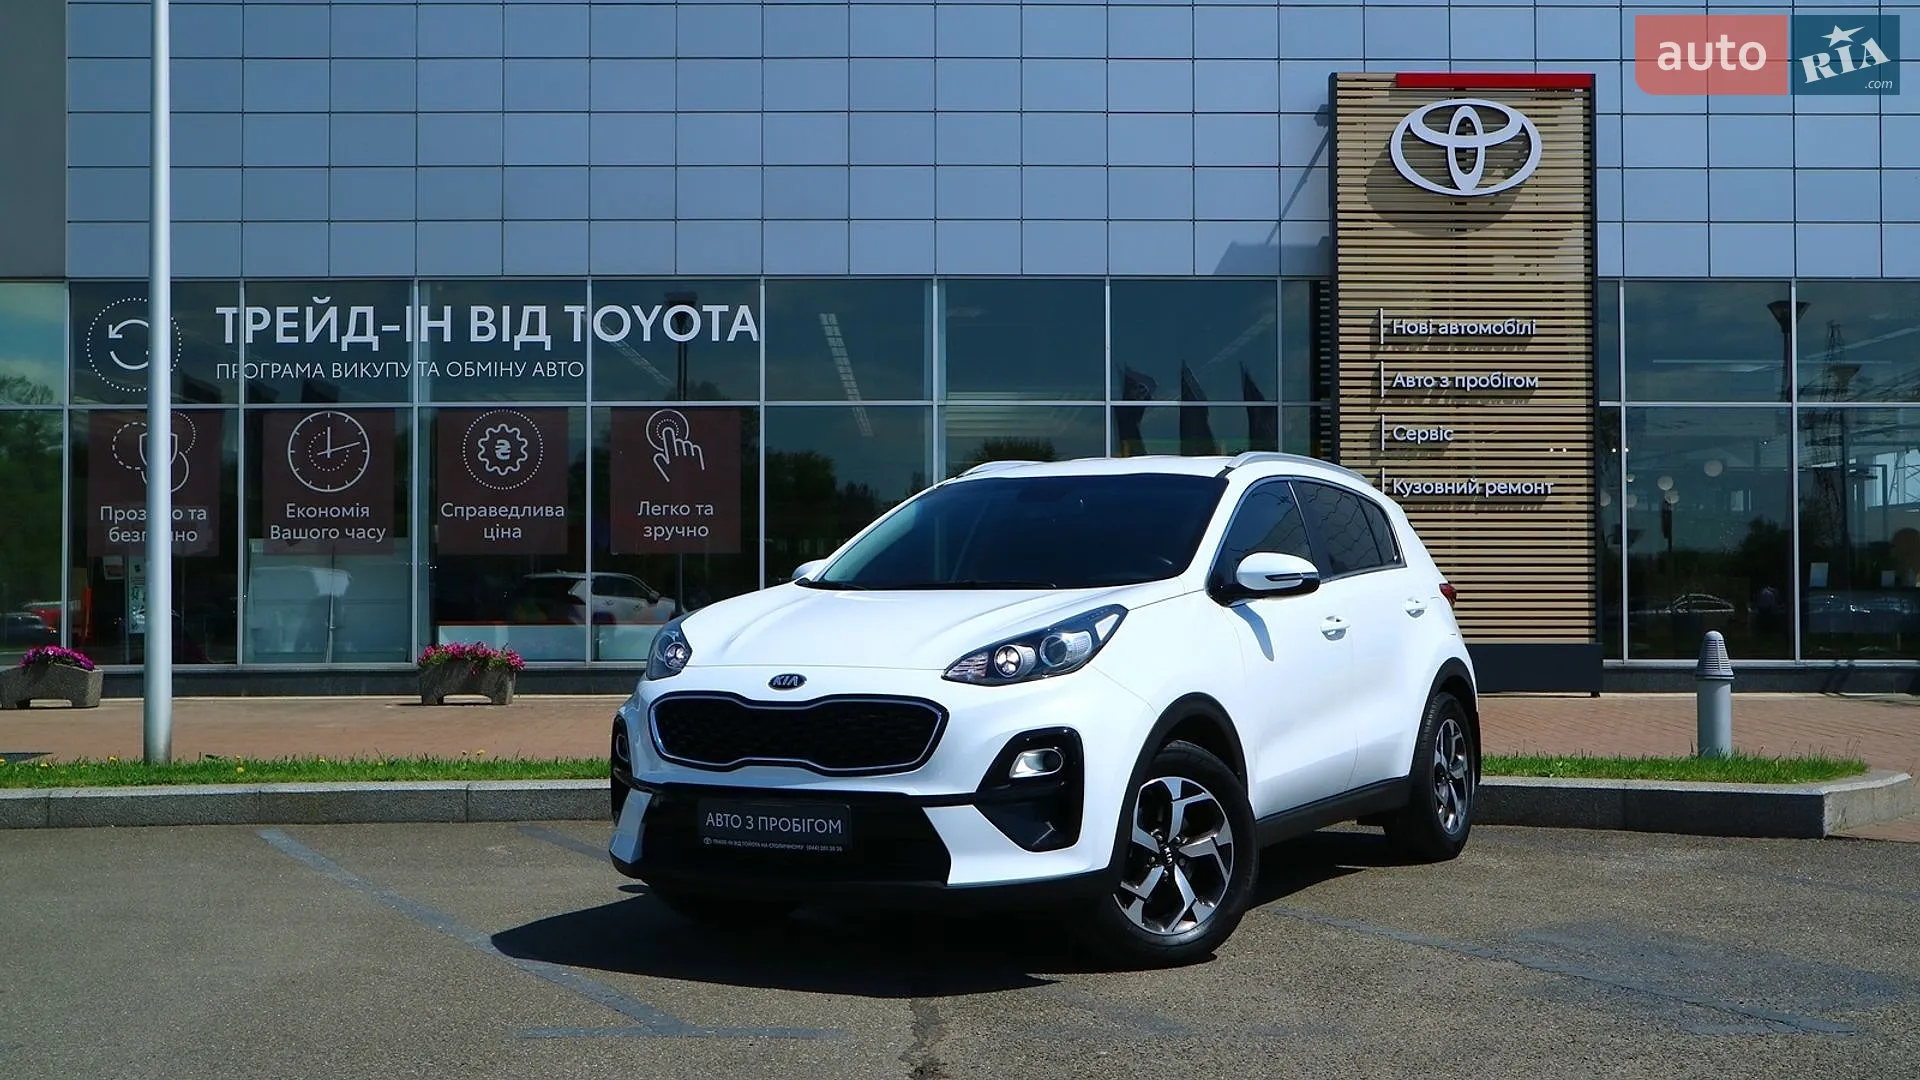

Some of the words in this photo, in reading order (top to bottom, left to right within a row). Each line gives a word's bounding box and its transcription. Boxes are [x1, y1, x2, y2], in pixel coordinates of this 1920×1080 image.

[215, 296, 451, 351] ТРЕЙД-ІН
[470, 304, 551, 351] ВІД
[564, 304, 761, 342] TOYOTA
[1393, 319, 1433, 335] Нові
[1438, 318, 1537, 335] автомобілі
[332, 361, 412, 379] ВИКУПУ
[418, 361, 440, 377] ТА
[446, 361, 527, 377] ОБМІНУ
[532, 361, 585, 377] АВТО
[1392, 371, 1435, 388] Авто
[1439, 375, 1450, 388] з
[1455, 371, 1539, 391] пробігом
[1393, 425, 1455, 444] Сервіс
[1393, 477, 1480, 497] Кузовний
[1485, 482, 1555, 498] ремонт
[100, 505, 183, 524] Прозо
[188, 508, 207, 521] та
[285, 503, 370, 519] Економія
[440, 502, 566, 520] Справедлива
[637, 501, 691, 516] Легко
[696, 504, 714, 516] та
[270, 525, 340, 540] Вашого
[345, 527, 387, 543] часу
[483, 524, 522, 540] ціна
[643, 525, 710, 541] зручно
[772, 675, 799, 686] KIA
[705, 812, 742, 829] АВТО
[758, 816, 843, 834] ПРОБІГОМ
